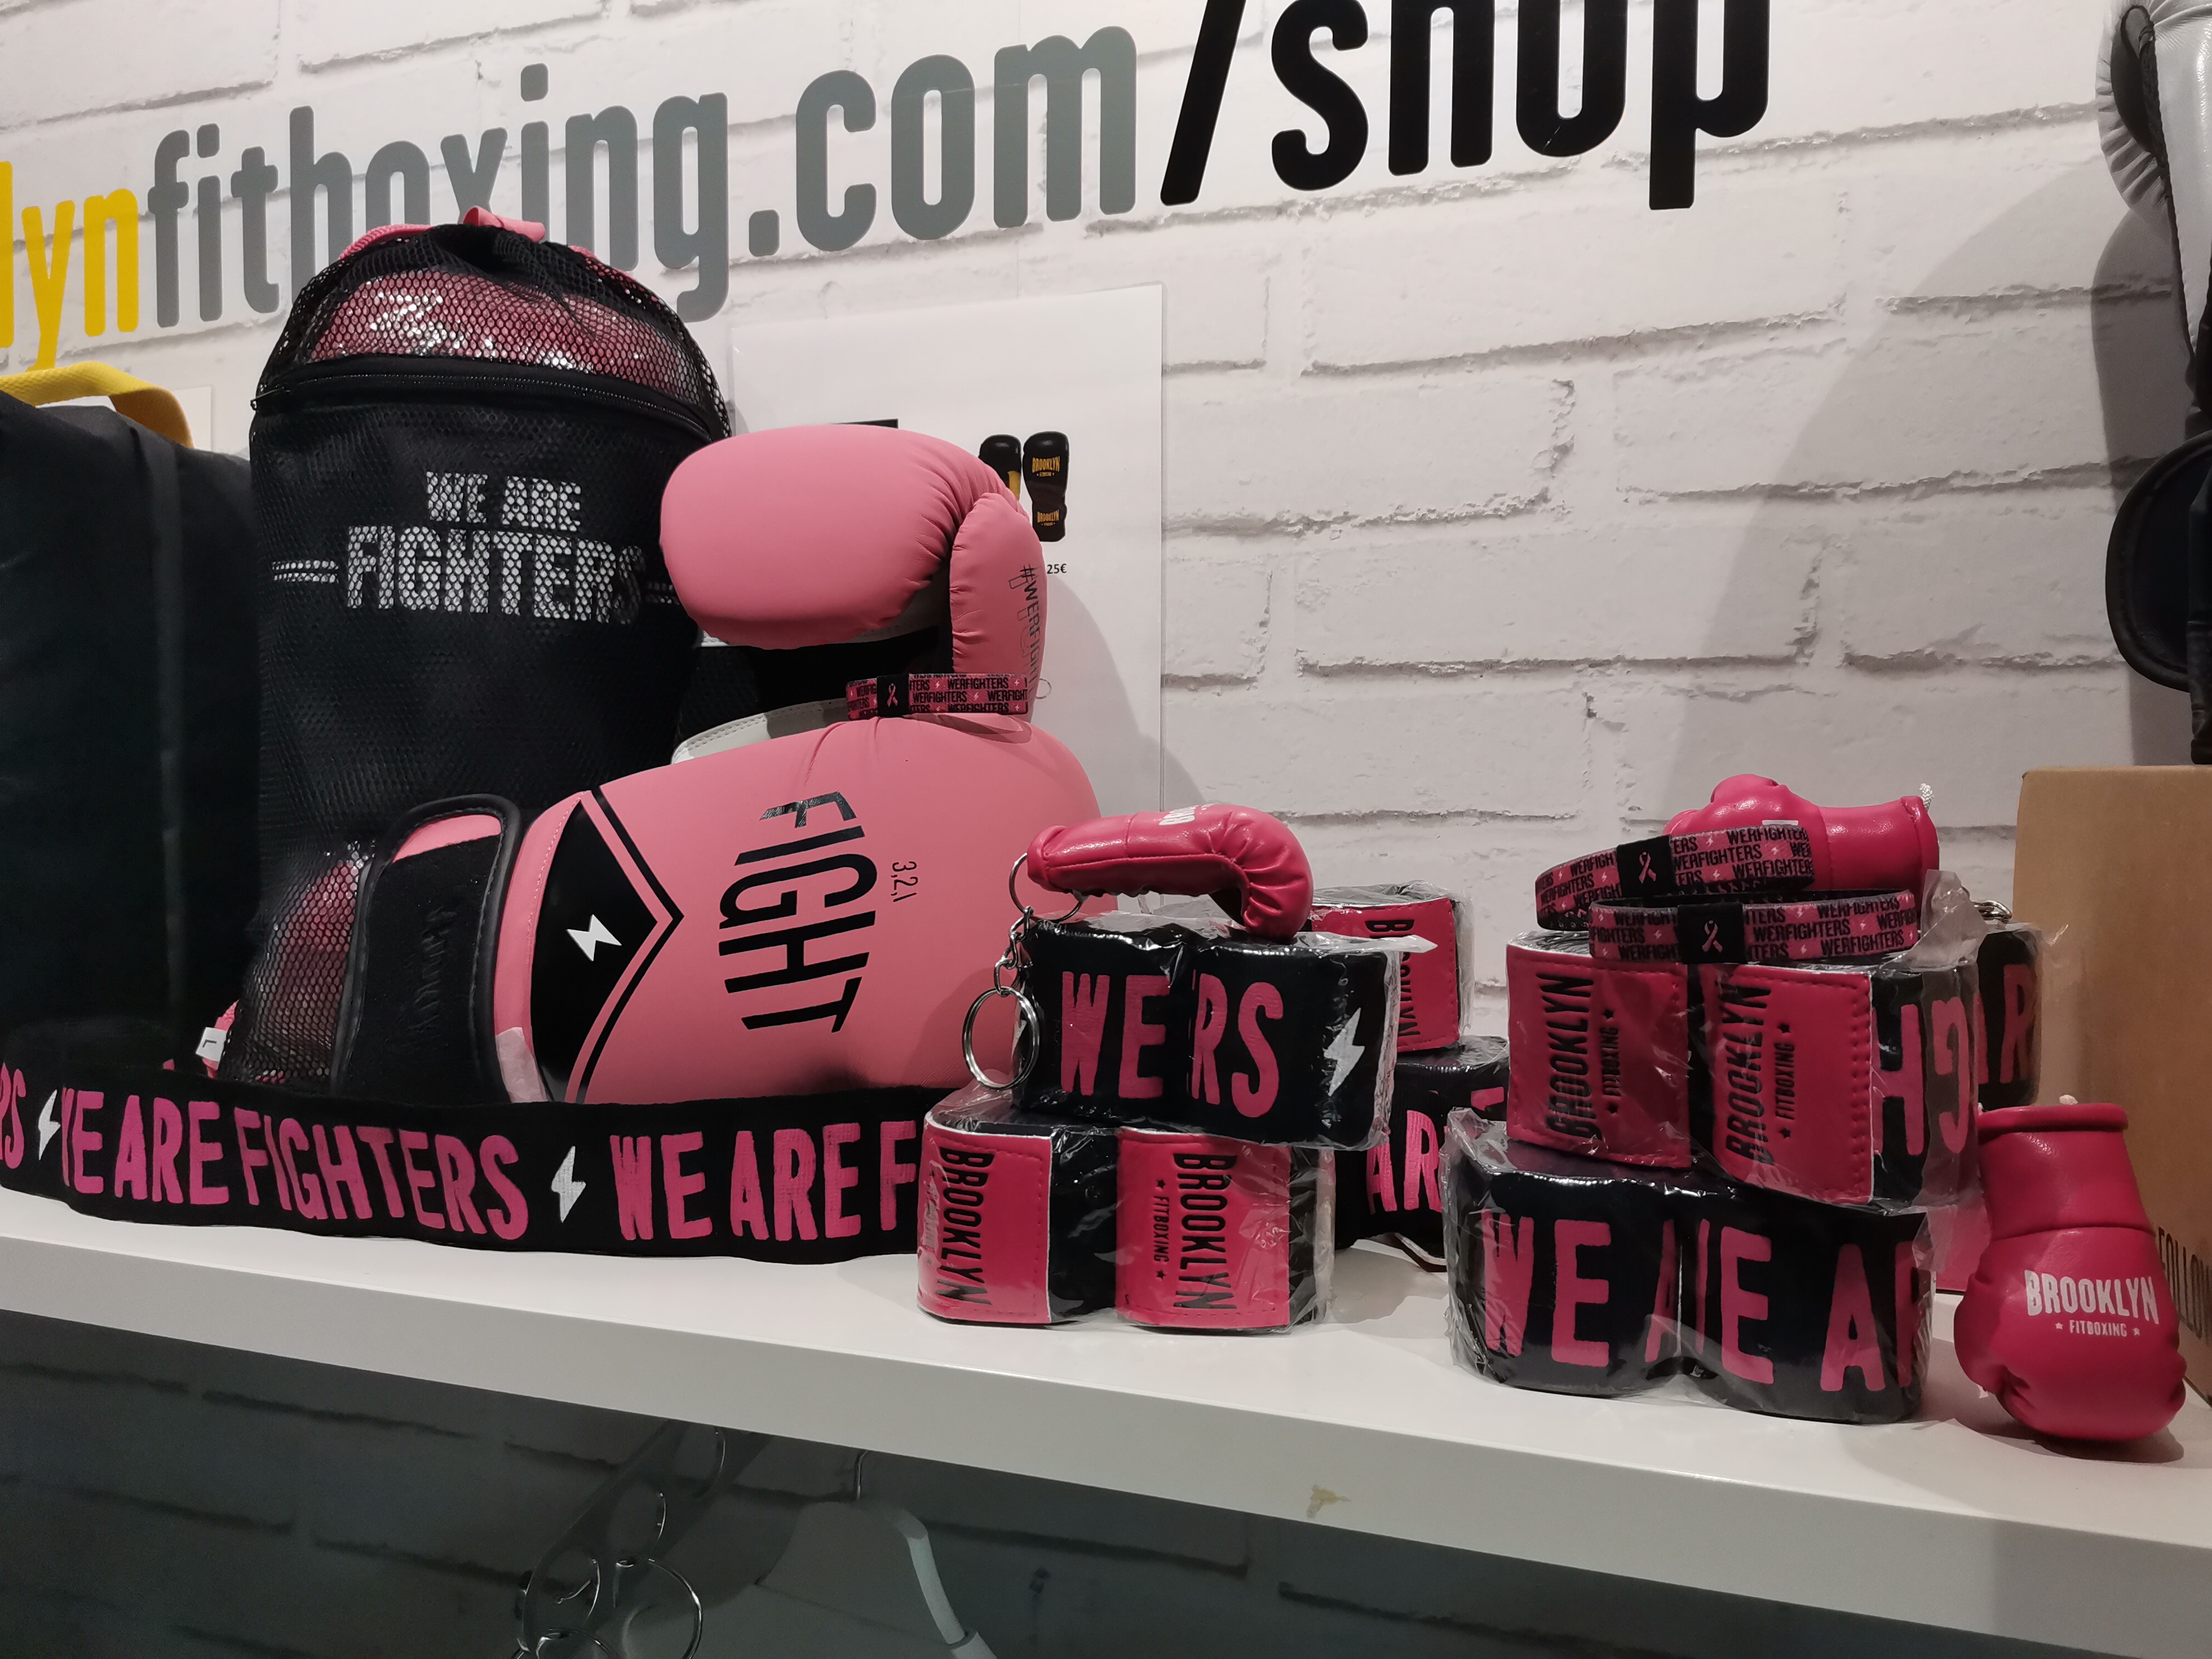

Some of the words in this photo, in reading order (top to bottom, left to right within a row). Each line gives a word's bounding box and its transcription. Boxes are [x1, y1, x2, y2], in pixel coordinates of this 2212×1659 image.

[1032, 456, 1060, 473] BROOKLYN
[426, 471, 488, 523] WE
[502, 476, 581, 531] ARE
[1037, 509, 1060, 523] BROOKLYN
[347, 525, 647, 625] FIGHTERS
[1046, 564, 1067, 574] 25€
[912, 690, 967, 704] WERFIGHTERS
[947, 677, 1009, 691] WERFIGHTERS
[719, 791, 878, 1033] FIGHT
[1752, 918, 1851, 942] WERFIGHTERS
[1820, 928, 1905, 956] WERFIGHTERS
[202, 1039, 217, 1048] L
[1773, 1042, 1796, 1120] FITBOXING
[114, 1094, 229, 1206] ARE
[234, 1106, 529, 1240] FIGHTERS
[610, 1131, 712, 1240] WE
[730, 1122, 861, 1241] ARE
[935, 1145, 995, 1306] BROOKLYN
[1152, 1196, 1170, 1264] FITBOXING
[1173, 1152, 1238, 1311] BROOKLYN
[1481, 1208, 1610, 1368] WE
[2024, 1269, 2159, 1324] BROOKLYN
[2069, 1319, 2128, 1337] FITBOXING
